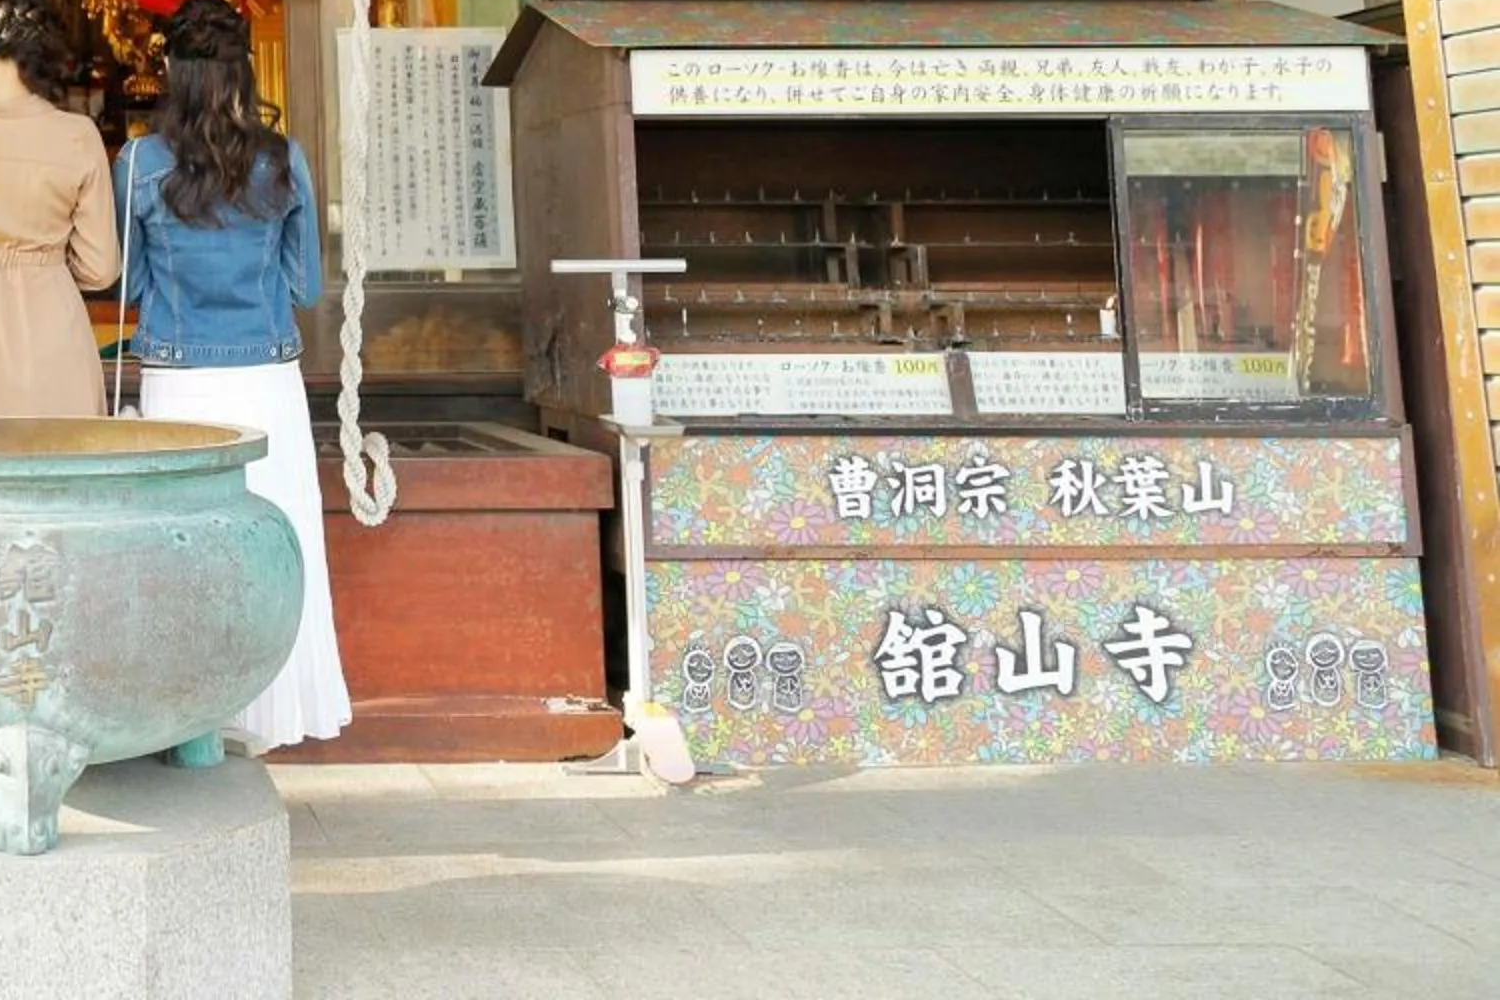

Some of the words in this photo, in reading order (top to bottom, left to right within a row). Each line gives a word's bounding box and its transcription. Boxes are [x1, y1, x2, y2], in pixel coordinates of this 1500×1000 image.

[828, 455, 1012, 519] 曹洞宗
[1049, 454, 1235, 520] 秋葉山
